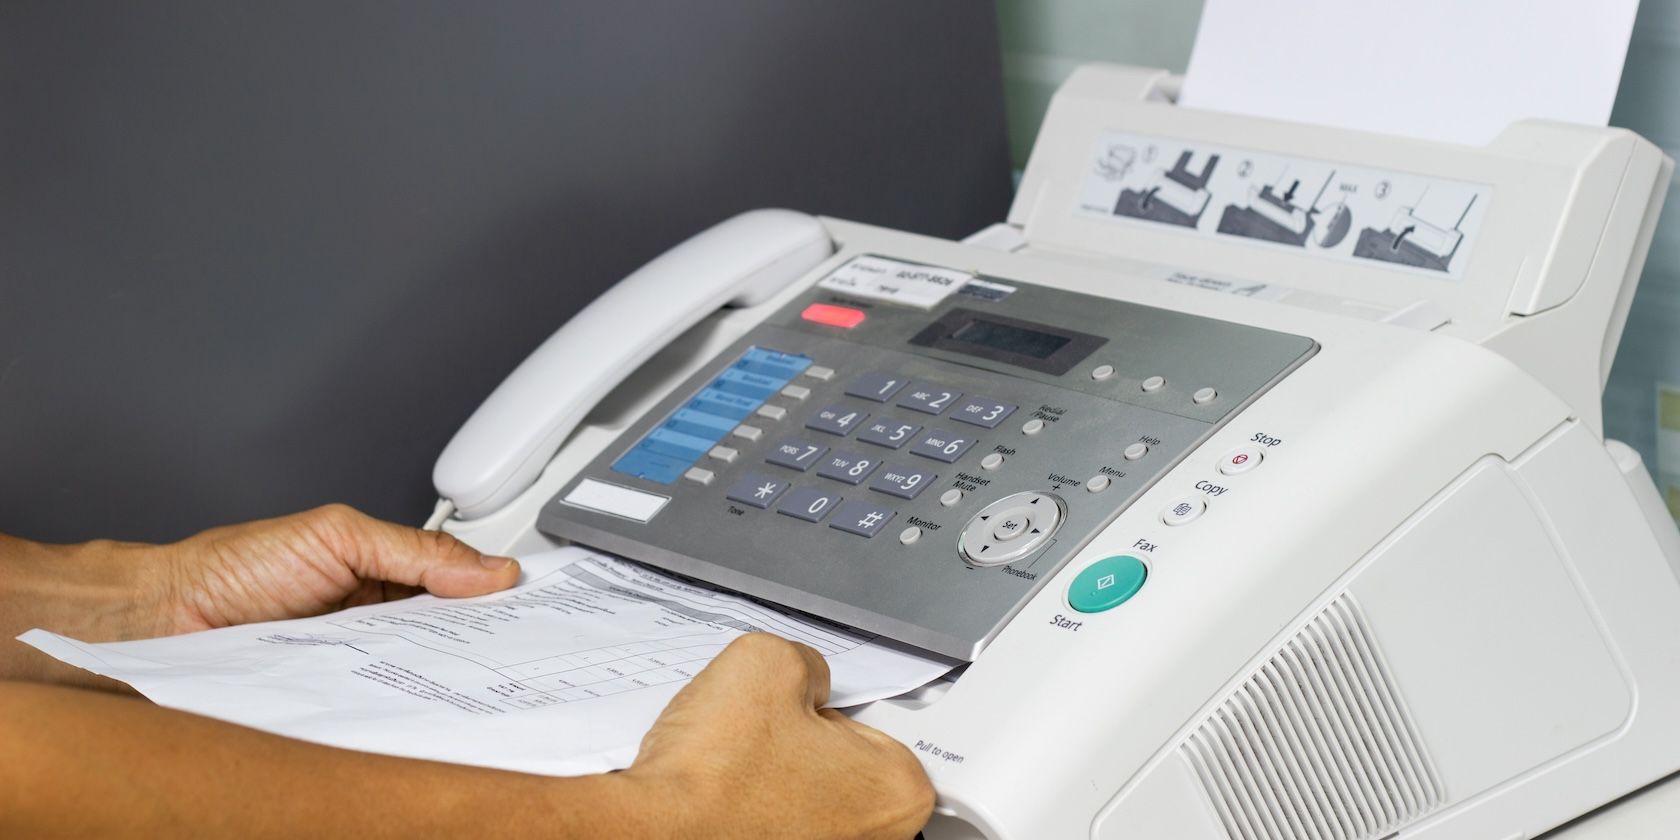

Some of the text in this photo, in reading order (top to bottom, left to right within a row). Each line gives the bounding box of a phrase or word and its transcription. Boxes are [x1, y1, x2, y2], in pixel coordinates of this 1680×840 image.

[878, 379, 896, 395] 1
[911, 391, 951, 409] ABC 2
[964, 404, 1005, 421] DEF 3
[1039, 404, 1068, 416] Redial
[836, 412, 857, 428] 4
[870, 424, 912, 441] JKL 5
[1138, 434, 1161, 446] Help
[1250, 432, 1282, 447] Stop
[779, 444, 818, 461] PQRS 7
[925, 437, 964, 454] MNO 6
[993, 444, 1016, 456] Flash
[832, 458, 869, 476] TUV 8
[1098, 466, 1127, 479] Menu
[884, 472, 922, 490] WXYZ 9
[952, 480, 977, 492] Mute
[955, 472, 990, 487] Handset
[1048, 472, 1081, 487] Volume
[1195, 480, 1230, 497] Copy
[808, 497, 829, 514] 0
[857, 511, 884, 529] #
[906, 516, 941, 531] Monitor
[1002, 520, 1018, 530] Set
[1132, 538, 1160, 553] Fax
[1001, 565, 1038, 581] Phonebook
[1049, 614, 1083, 632] Start
[914, 740, 965, 764] Pull to open
